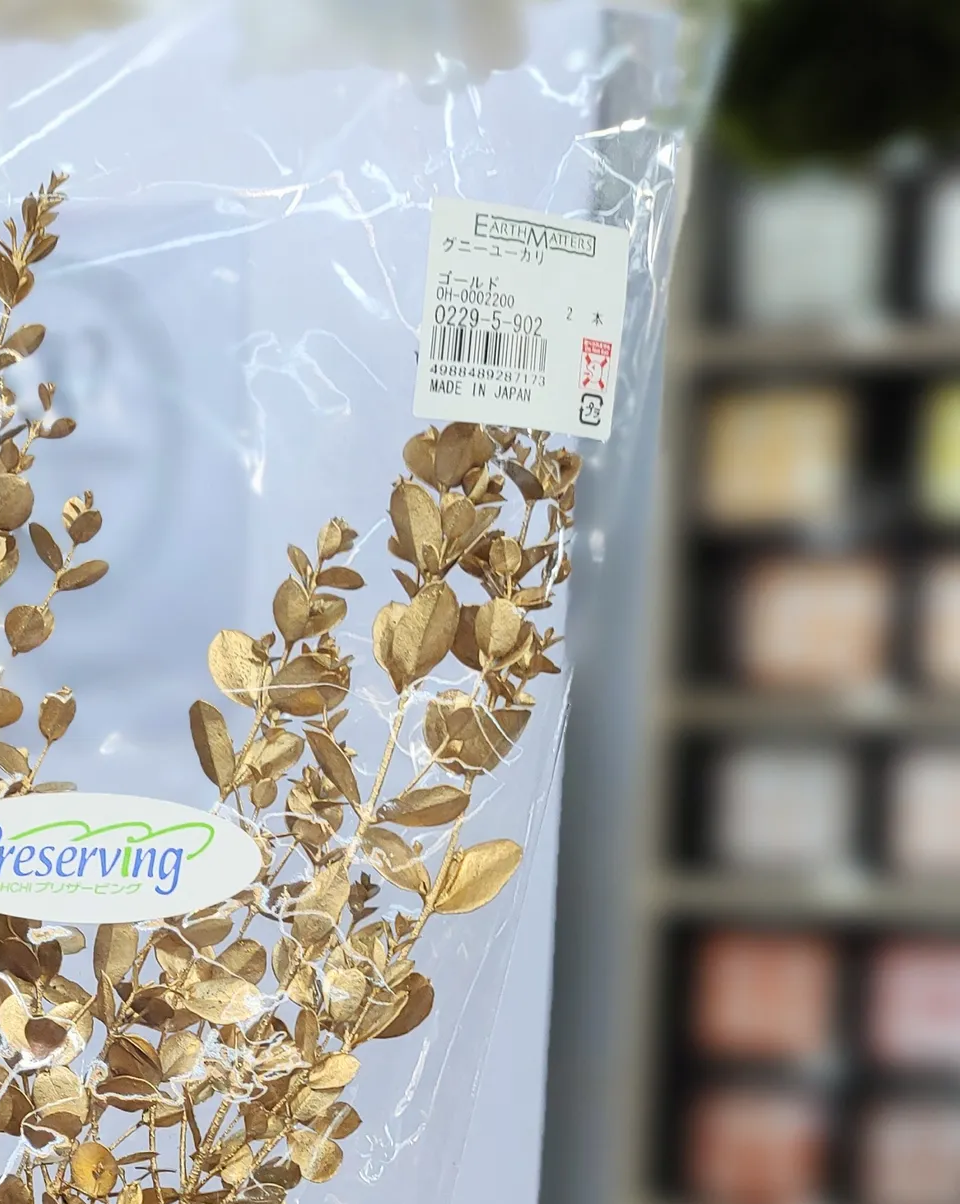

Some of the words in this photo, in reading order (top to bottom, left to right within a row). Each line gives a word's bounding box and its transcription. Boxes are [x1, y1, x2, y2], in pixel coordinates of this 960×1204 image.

[442, 236, 545, 265] グニーユーカリ
[438, 270, 500, 291] ゴールド
[435, 304, 543, 336] 0229-5-902
[566, 306, 573, 321] 2
[430, 363, 546, 388] 4988489287173
[430, 378, 463, 396] MADE
[472, 381, 486, 397] IN
[494, 385, 532, 403] JAPAN
[34, 881, 143, 895] プリザービング
